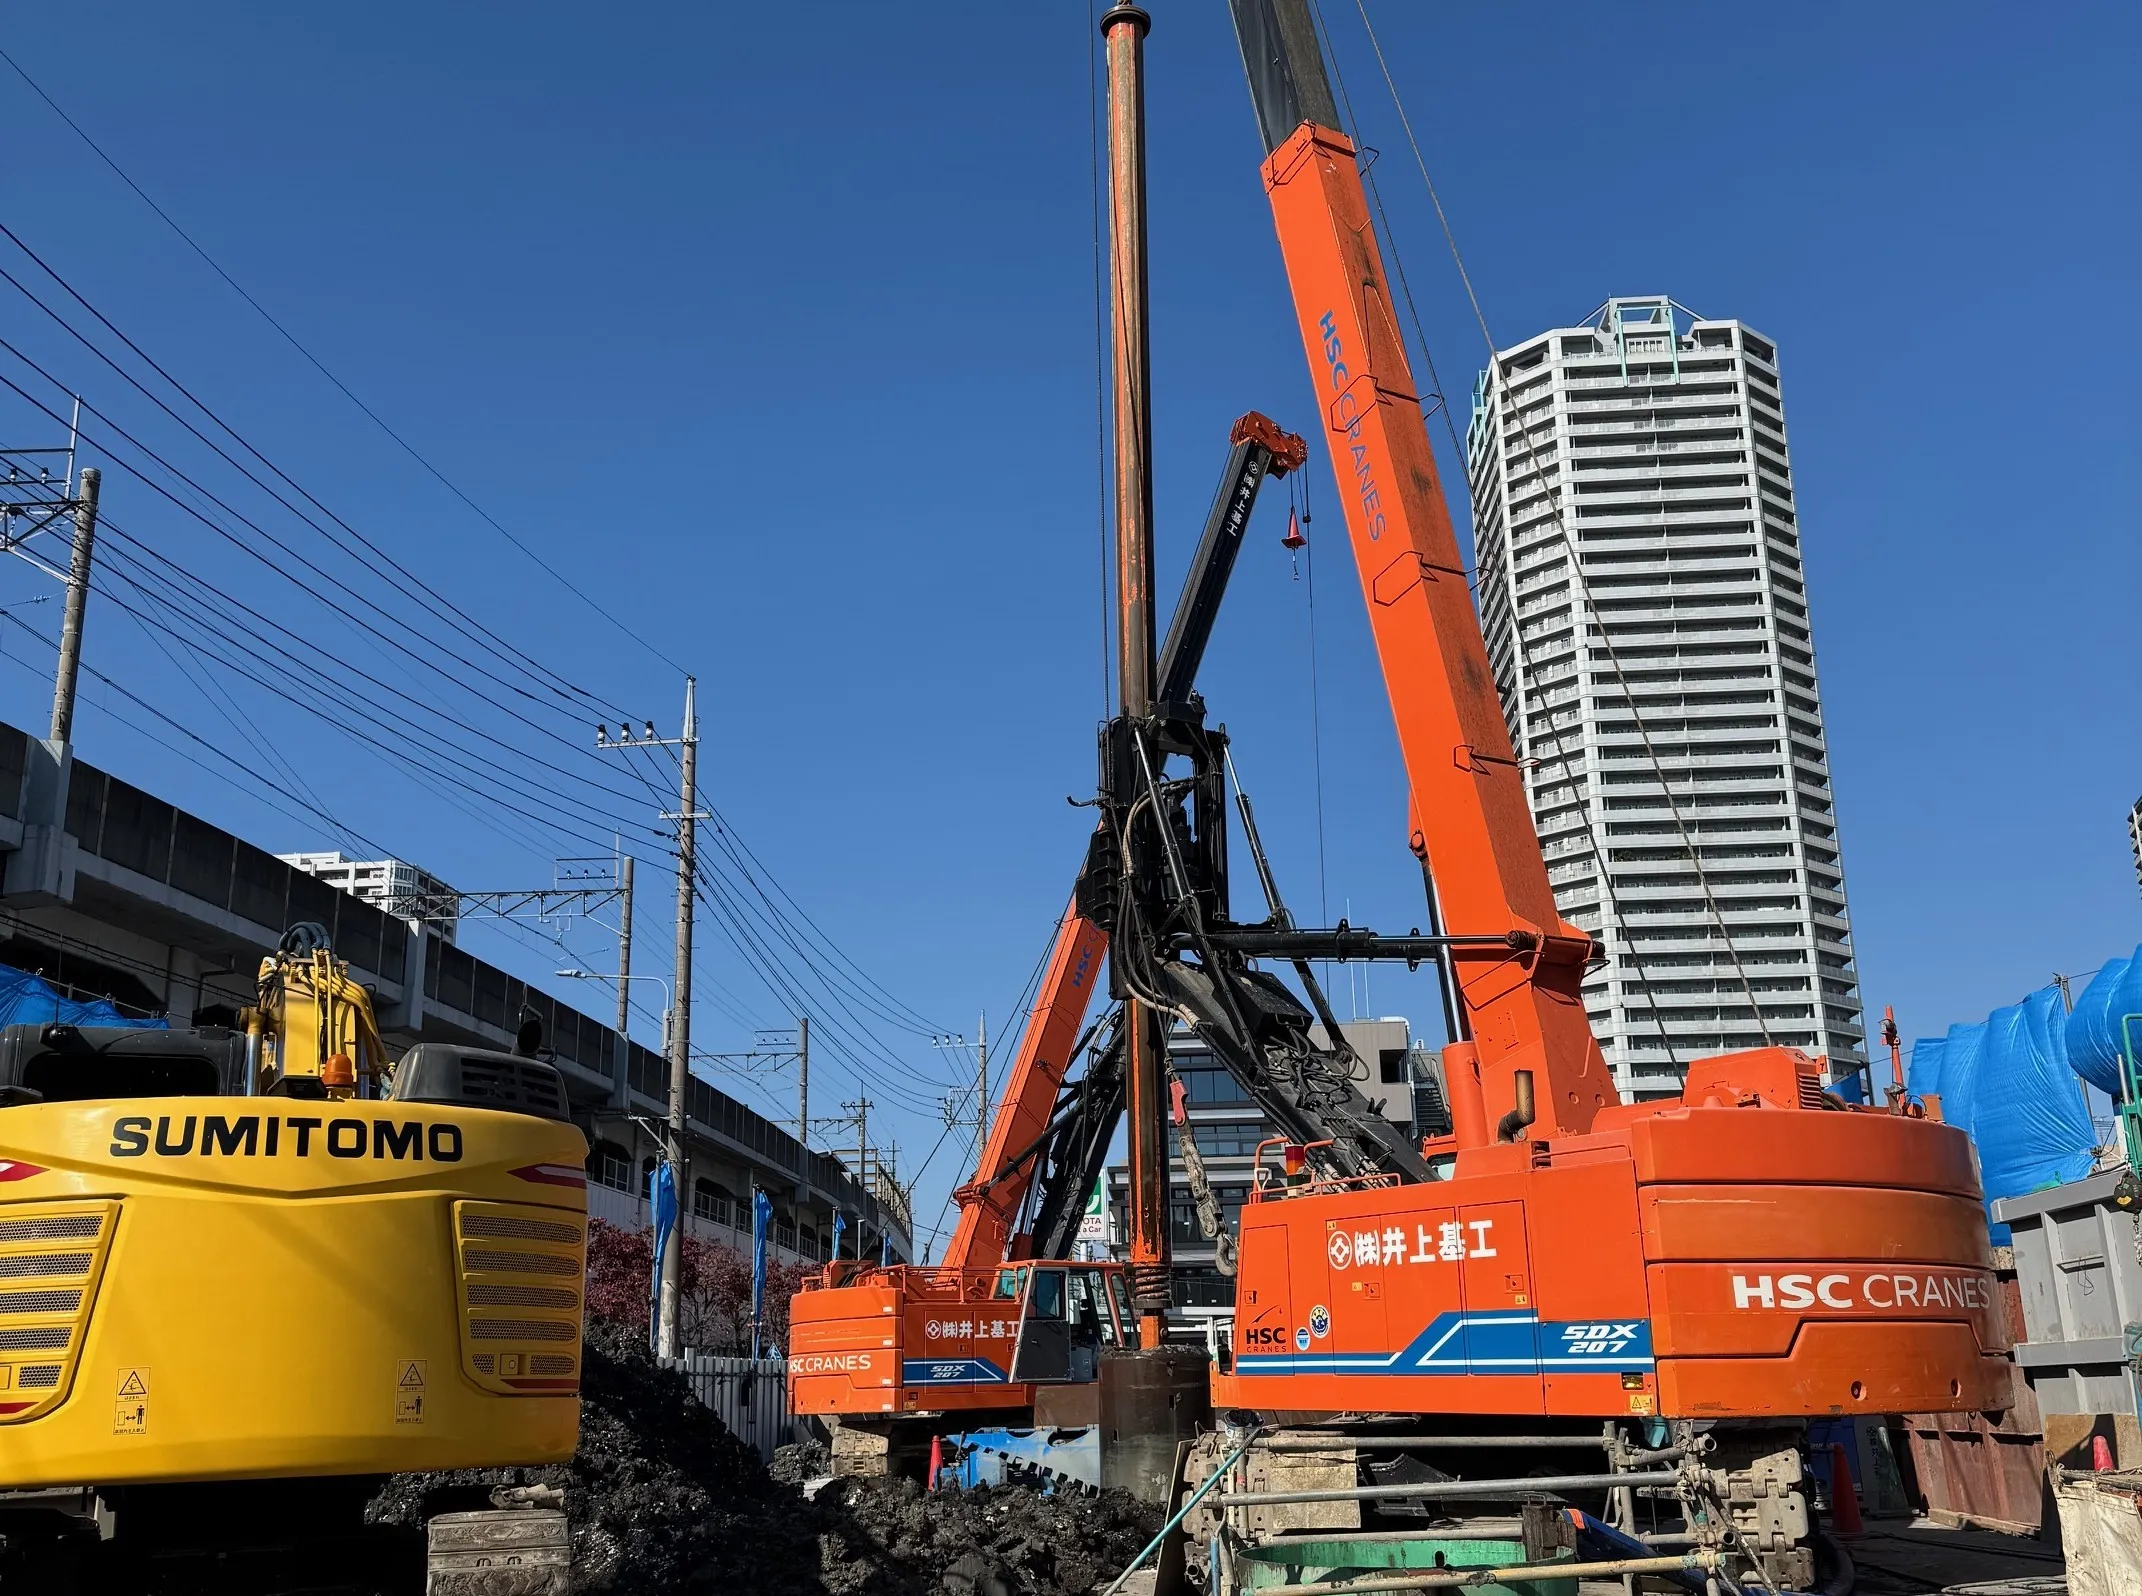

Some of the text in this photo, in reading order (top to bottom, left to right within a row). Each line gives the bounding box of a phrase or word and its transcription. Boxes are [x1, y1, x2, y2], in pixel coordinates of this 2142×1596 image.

[1319, 309, 1386, 541] HSC CRANES
[109, 1116, 464, 1162] SUMITOMO
[1083, 1217, 1101, 1225] OTA
[1732, 1274, 1990, 1309] HSC CRANES
[1246, 1327, 1286, 1345] HSC
[1560, 1324, 1639, 1340] SDX
[1567, 1341, 1629, 1353] 207
[805, 1355, 872, 1373] CRANES
[930, 1364, 966, 1372] SDX
